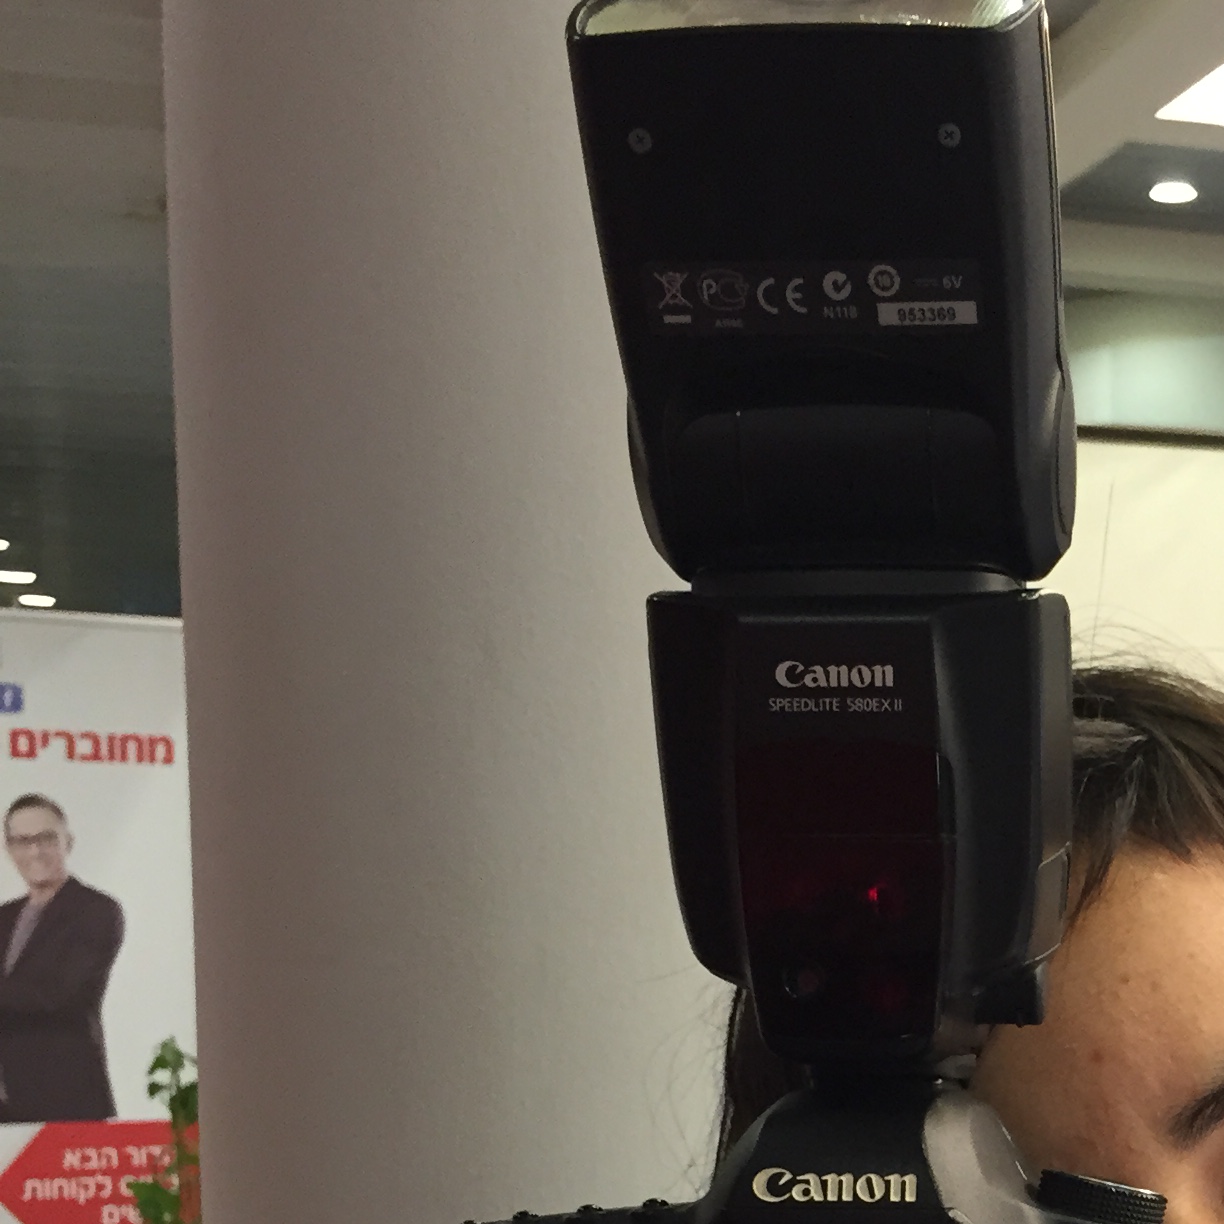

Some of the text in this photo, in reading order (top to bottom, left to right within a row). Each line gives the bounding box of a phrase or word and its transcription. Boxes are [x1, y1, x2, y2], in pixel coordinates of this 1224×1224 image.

[774, 660, 894, 689] Canon
[768, 697, 841, 712] SPEEDLITE
[9, 727, 175, 765] מחוברים
[62, 1146, 119, 1170] הבא
[22, 1173, 113, 1205] לקוחות
[752, 1167, 917, 1203] Canon
